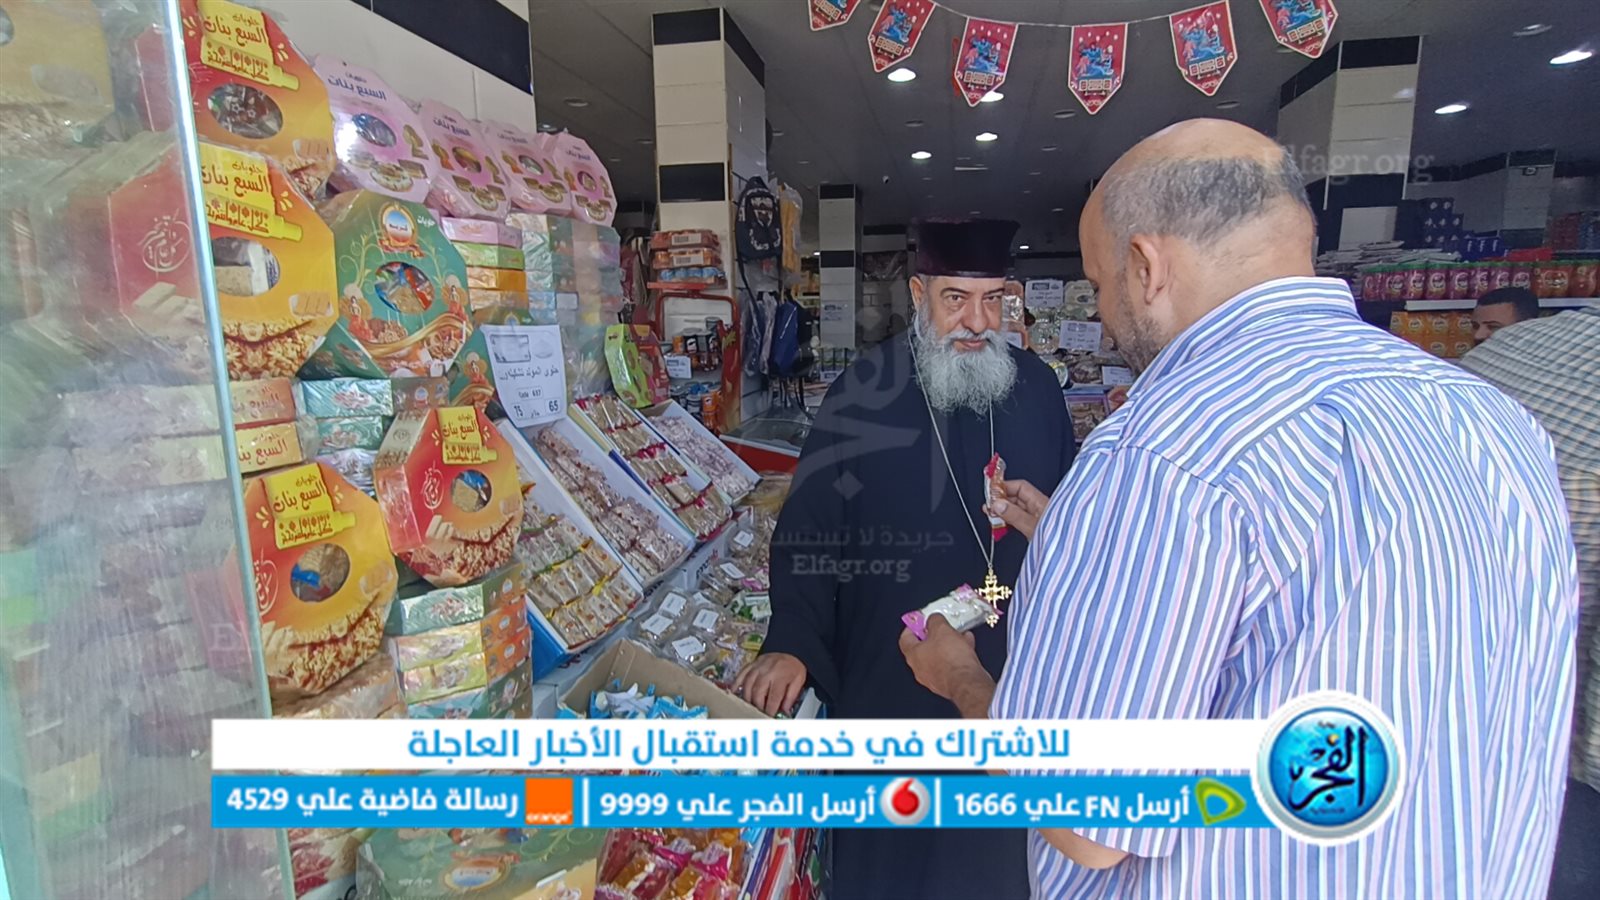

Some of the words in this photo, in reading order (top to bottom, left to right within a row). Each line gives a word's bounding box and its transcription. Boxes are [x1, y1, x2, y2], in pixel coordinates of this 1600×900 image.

[203, 15, 232, 41] بنات
[236, 27, 267, 47] السبع
[327, 75, 354, 91] بنات
[356, 86, 387, 101] السبع
[232, 161, 263, 175] حلويات
[234, 174, 269, 198] السبع
[548, 400, 559, 412] 65
[256, 438, 288, 466] السبع
[296, 474, 317, 487] حلويات
[273, 490, 298, 512] بنات
[300, 480, 326, 511] السبع
